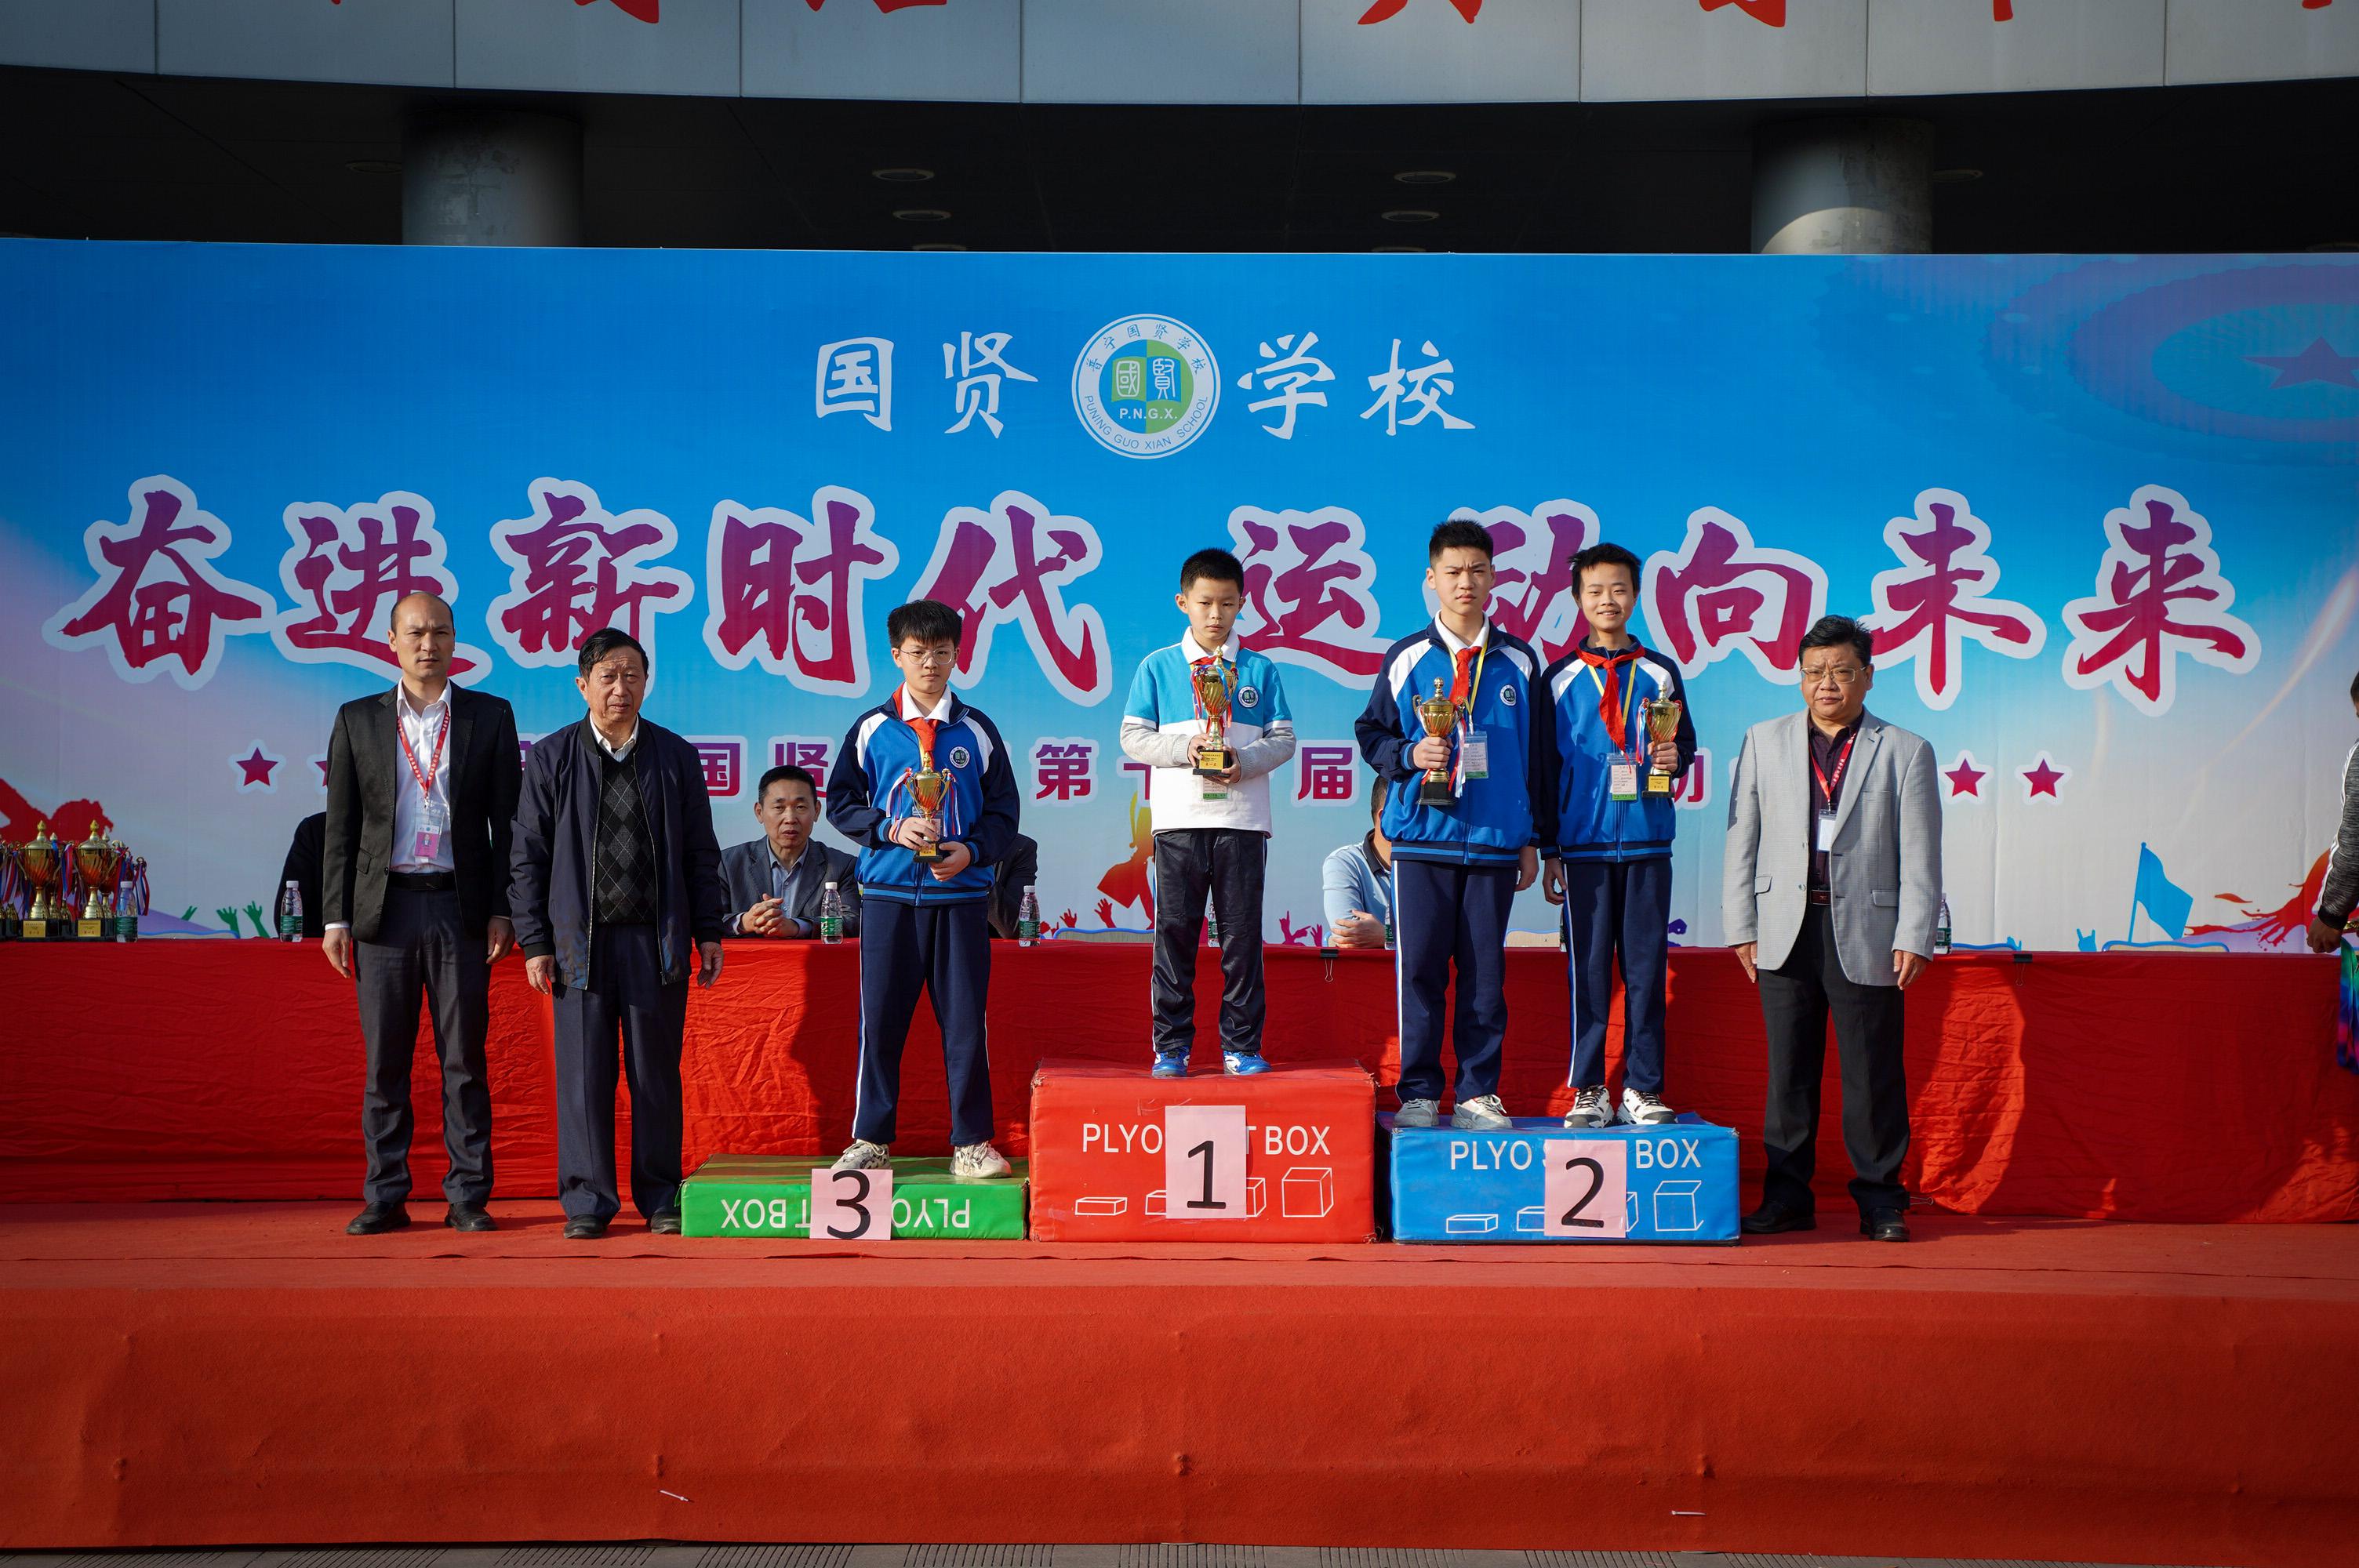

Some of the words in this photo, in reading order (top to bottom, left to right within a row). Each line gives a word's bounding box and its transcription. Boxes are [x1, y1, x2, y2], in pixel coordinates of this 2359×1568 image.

[816, 331, 1038, 438] 国贤
[1237, 332, 1475, 440] 学校
[1120, 408, 1178, 419] P.N.G.X.
[1085, 394, 1112, 436] PUNING
[1114, 434, 1140, 449] GUO
[1144, 436, 1172, 450] XIAN
[1176, 396, 1209, 438] SCHOOL
[60, 489, 1098, 691] 奋进新时代
[1082, 1123, 1163, 1154] PLYO
[1265, 1125, 1331, 1156] BOX
[1450, 1140, 1532, 1171] PLYO
[1635, 1138, 1701, 1169] BOX
[1187, 1140, 1227, 1209] 1
[1561, 1157, 1605, 1229] 2
[721, 1199, 787, 1229] BOX
[827, 1170, 871, 1239] 3
[891, 1198, 970, 1229] PLYO
